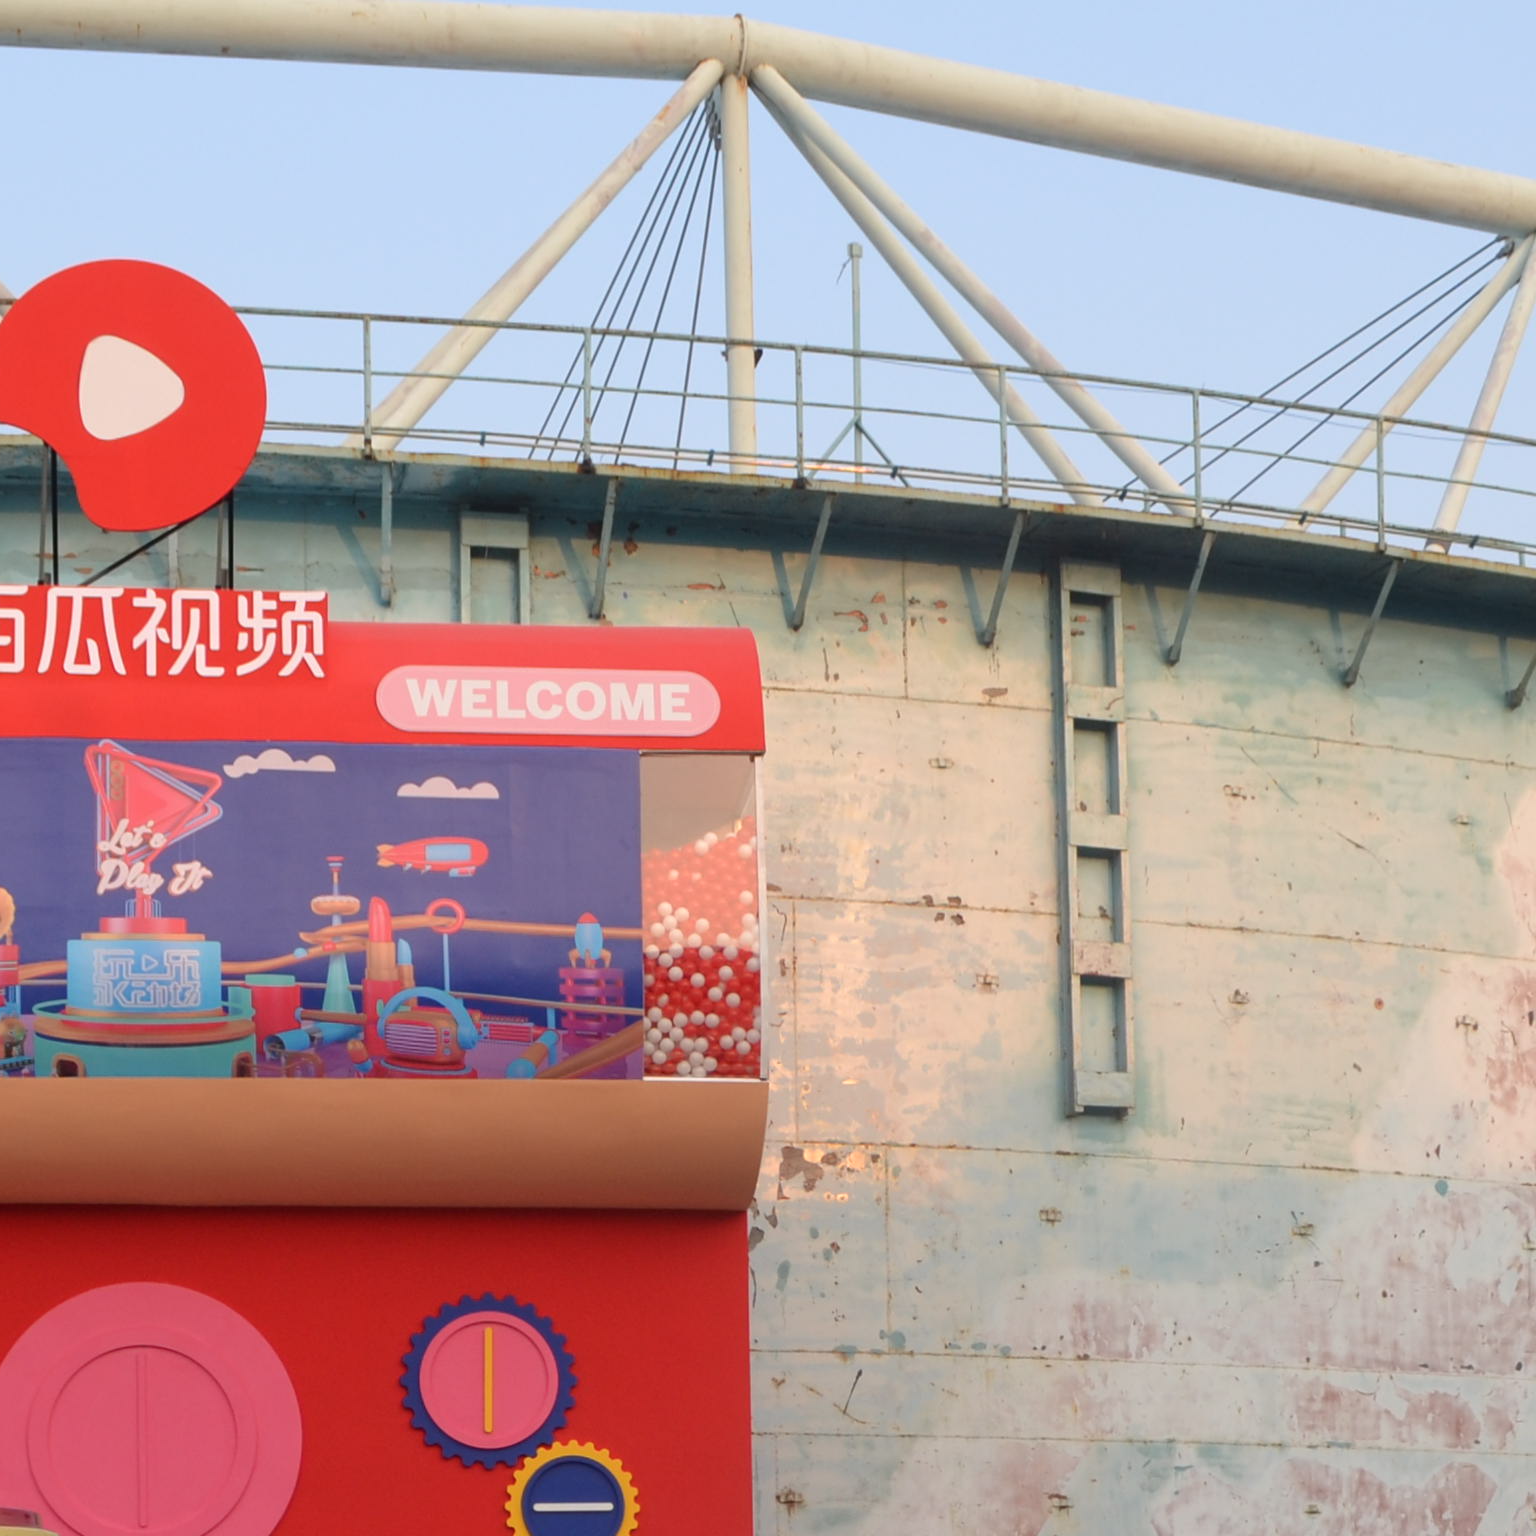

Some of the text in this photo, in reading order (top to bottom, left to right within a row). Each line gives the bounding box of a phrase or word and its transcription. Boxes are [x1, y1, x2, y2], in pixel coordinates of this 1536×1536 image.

[406, 679, 692, 721] WELCOME
[97, 858, 213, 895] Play It
